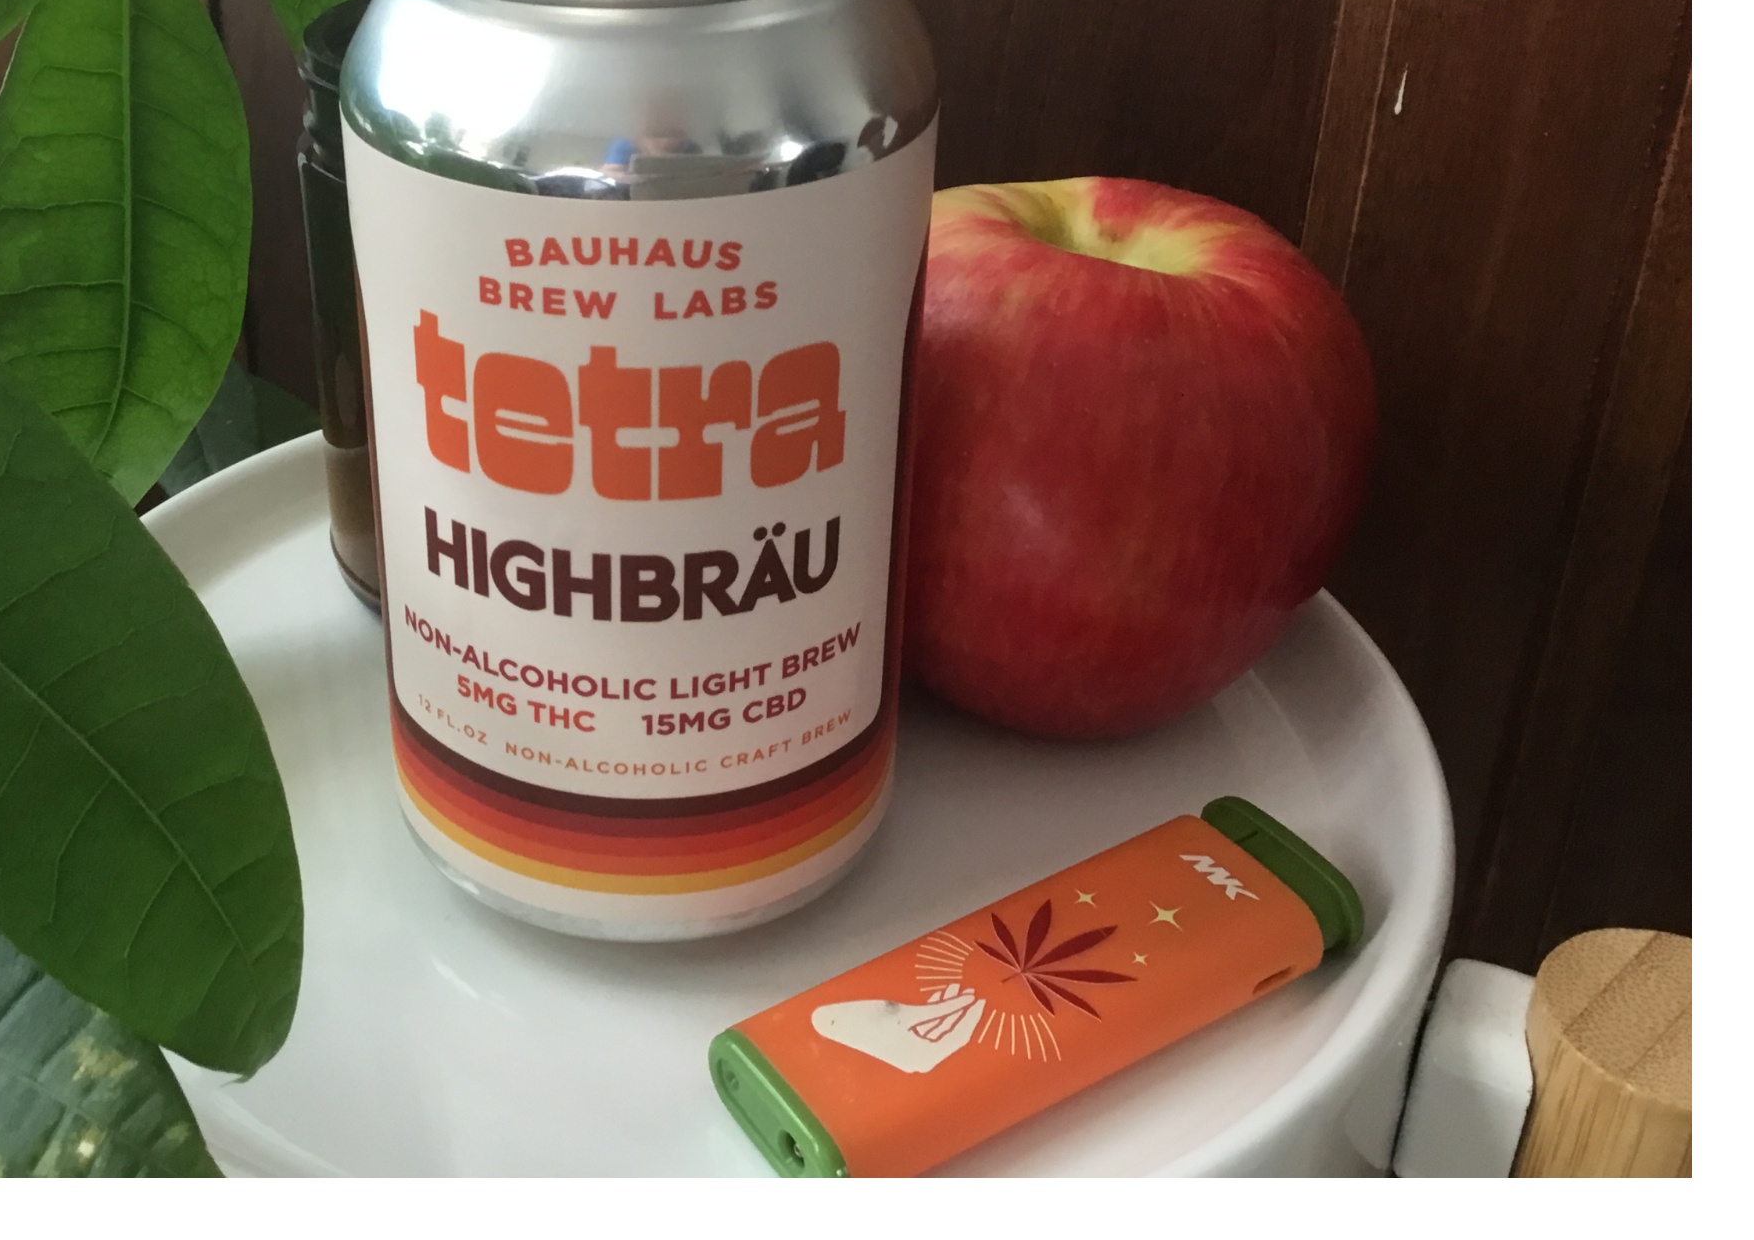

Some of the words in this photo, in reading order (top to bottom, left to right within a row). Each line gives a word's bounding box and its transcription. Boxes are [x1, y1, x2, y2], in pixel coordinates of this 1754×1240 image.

[504, 236, 743, 271] BAUHAUS
[478, 274, 617, 320] BREW
[654, 280, 779, 321] LABS
[413, 308, 847, 502] tetra
[424, 505, 842, 624] HIGHBRÄU
[404, 603, 658, 701] NON-ALCOHOLIC
[670, 661, 772, 701] LIGHT
[781, 621, 862, 681] BREW
[418, 693, 432, 713] 12
[505, 741, 708, 776] NON-ALCOHOLIC
[720, 738, 793, 769] CRAFT
[801, 708, 852, 746] BREW
[457, 673, 517, 716] 5MG
[527, 699, 596, 733] THC
[641, 707, 731, 736] 15MG
[742, 687, 807, 724] CBD
